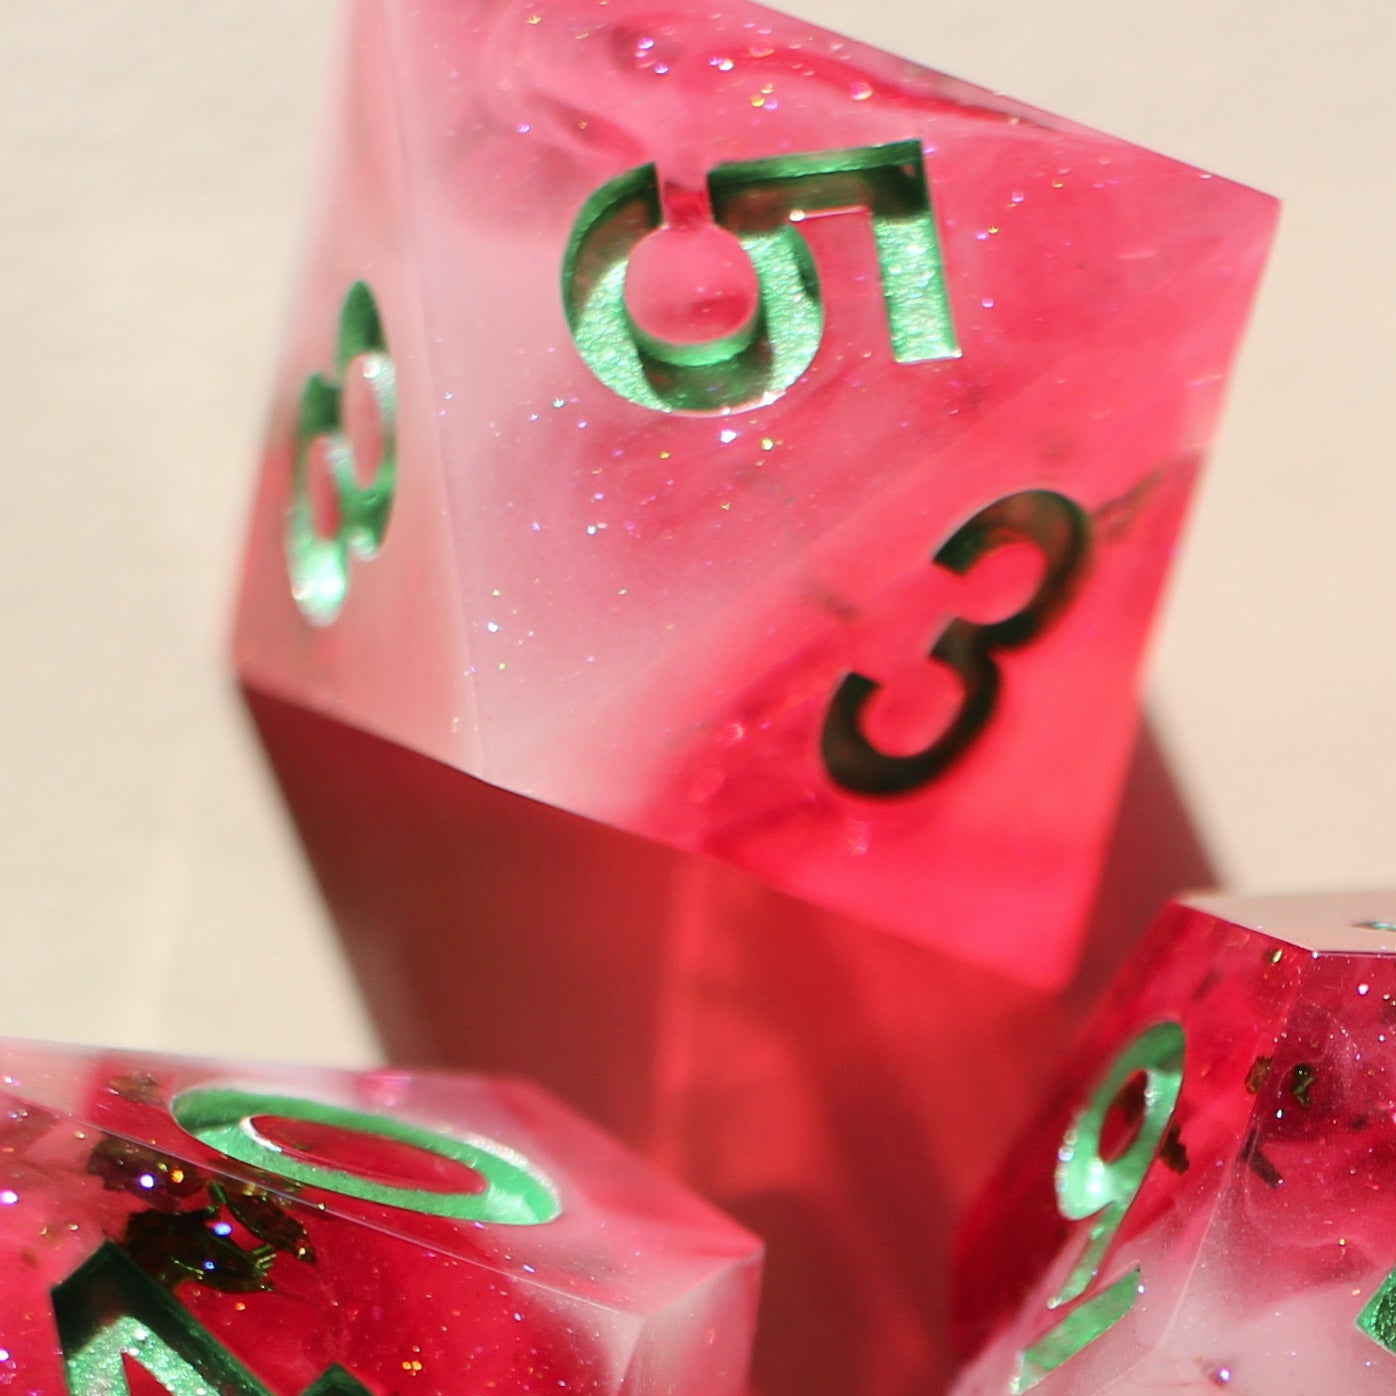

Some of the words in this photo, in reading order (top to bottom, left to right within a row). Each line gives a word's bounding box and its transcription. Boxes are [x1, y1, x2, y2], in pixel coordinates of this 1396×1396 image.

[560, 138, 962, 418] 5
[284, 279, 399, 628] 8
[820, 488, 1093, 801] 3
[170, 1085, 562, 1226] 0
